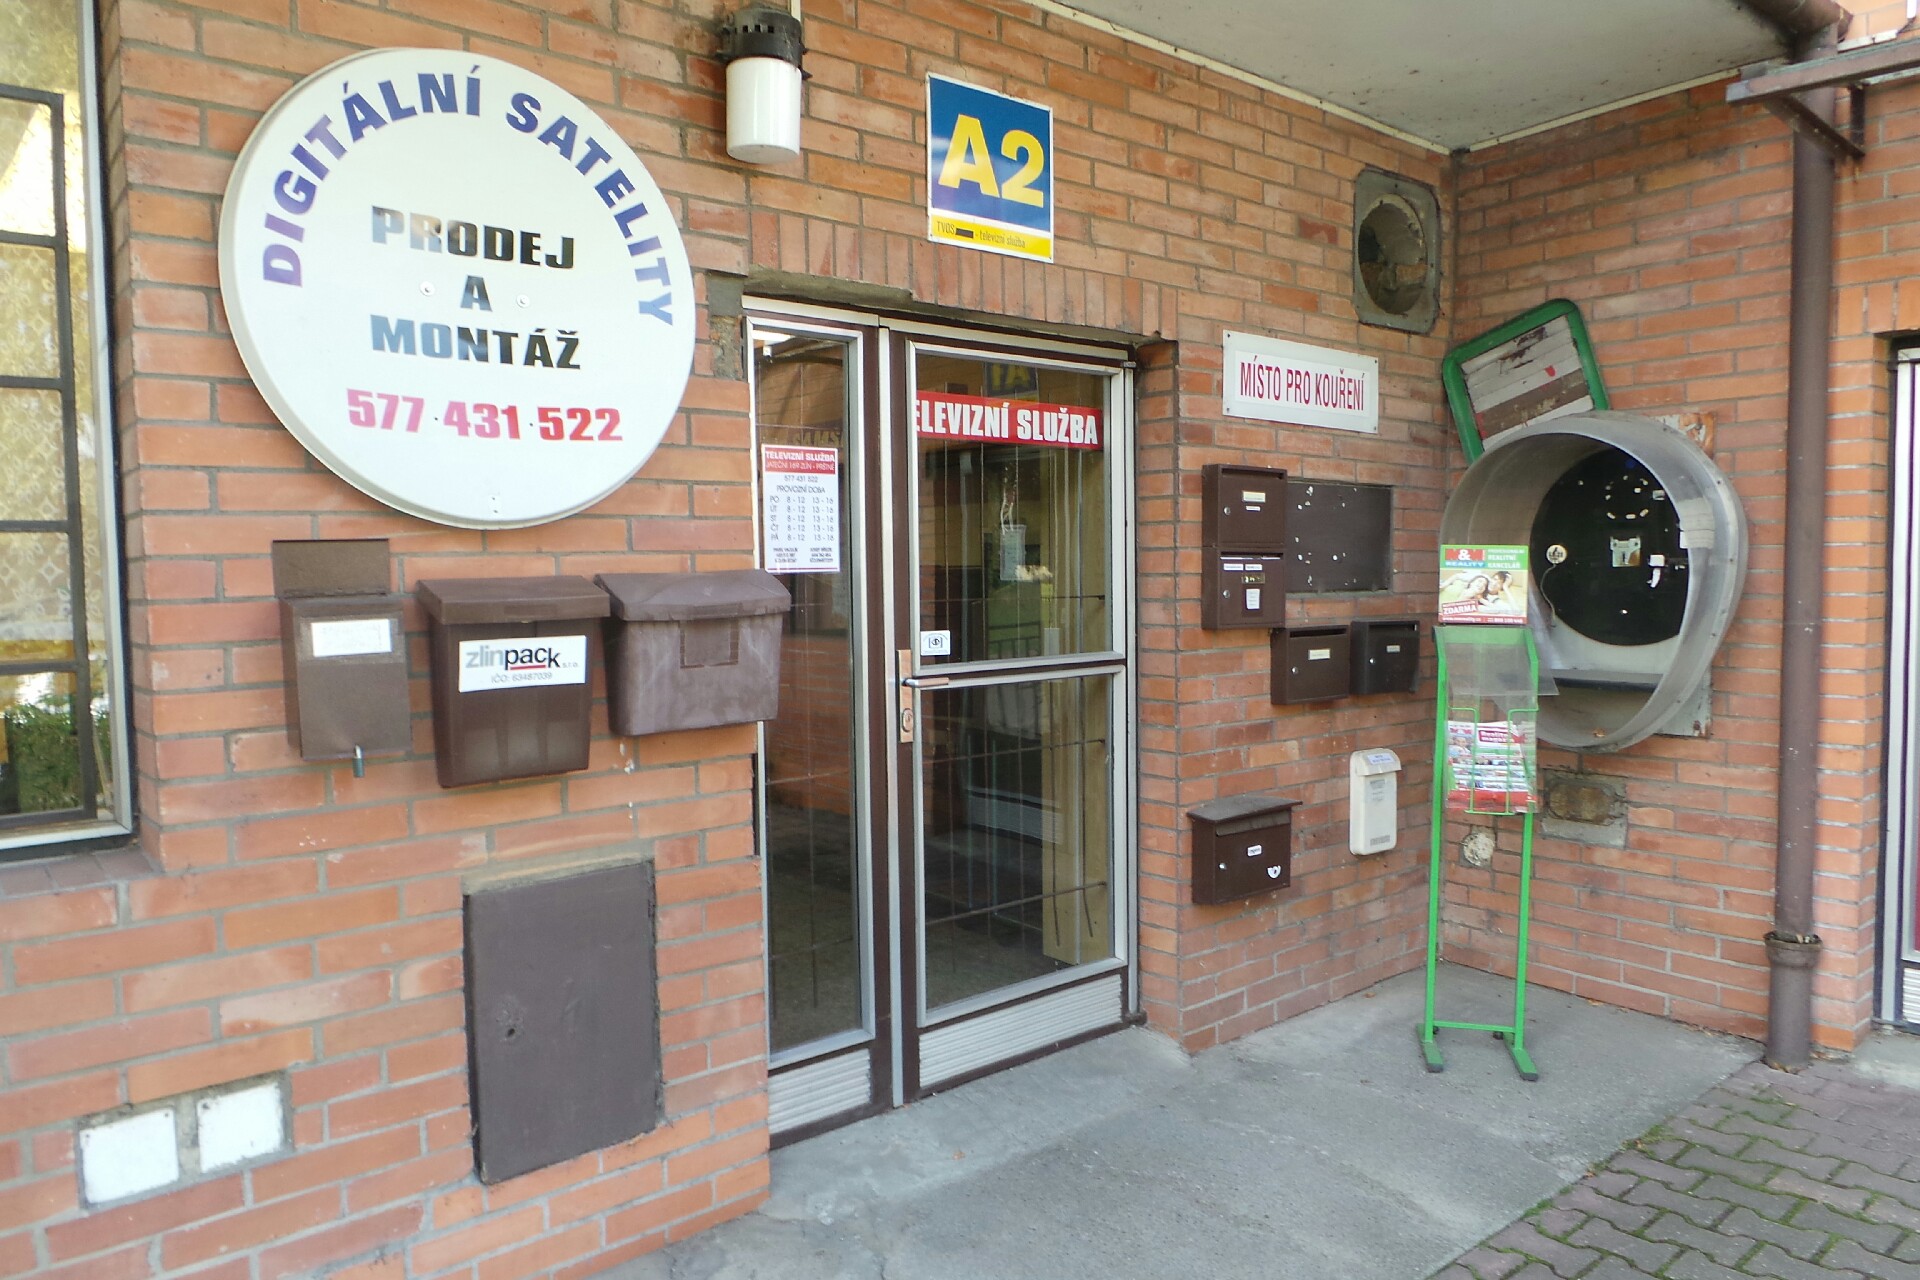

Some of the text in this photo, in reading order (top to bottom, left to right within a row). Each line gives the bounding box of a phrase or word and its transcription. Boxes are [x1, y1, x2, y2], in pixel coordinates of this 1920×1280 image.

[938, 113, 1045, 209] A2
[262, 65, 674, 326] DIGITÁLNÍ SATELITY
[371, 205, 575, 269] PRODEJ
[459, 274, 493, 312] A
[370, 314, 581, 370] MONTÁŽ
[1240, 355, 1364, 411] MÍSTO PRO KOUŘENÍ
[346, 388, 624, 441] 577 431 522
[1017, 407, 1098, 445] SLUŽBA
[766, 450, 835, 462] TELEVIZNÍ SLUŽBA
[777, 484, 807, 493] PROVOZNÍ
[1444, 604, 1476, 615] ZDARMA
[466, 645, 561, 670] zlinpack
